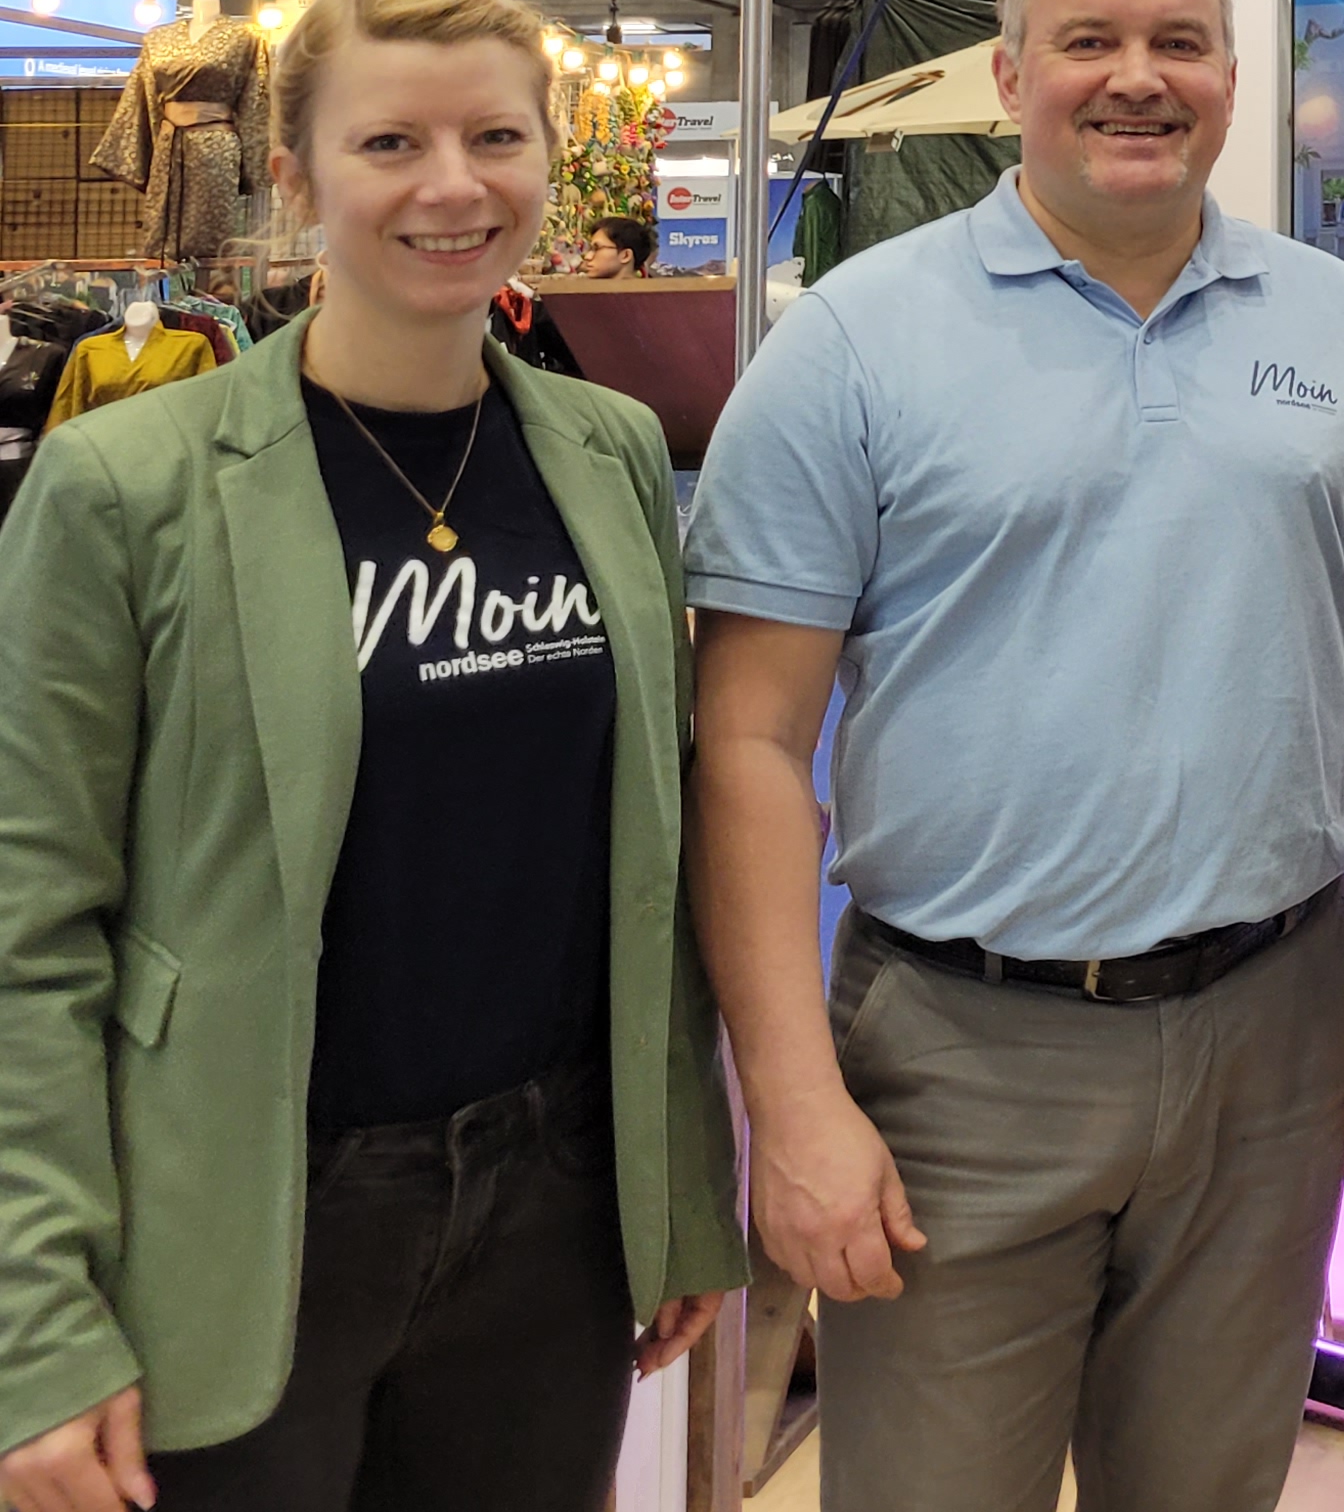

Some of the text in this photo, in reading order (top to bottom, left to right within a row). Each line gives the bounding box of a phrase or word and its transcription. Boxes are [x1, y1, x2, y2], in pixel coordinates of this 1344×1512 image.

[677, 115, 714, 127] Travel
[692, 193, 721, 203] Travel
[669, 232, 718, 248] Skyros
[1250, 360, 1338, 405] Moin
[352, 556, 601, 673] Moin
[419, 648, 525, 683] nordsee
[527, 654, 546, 664] Der
